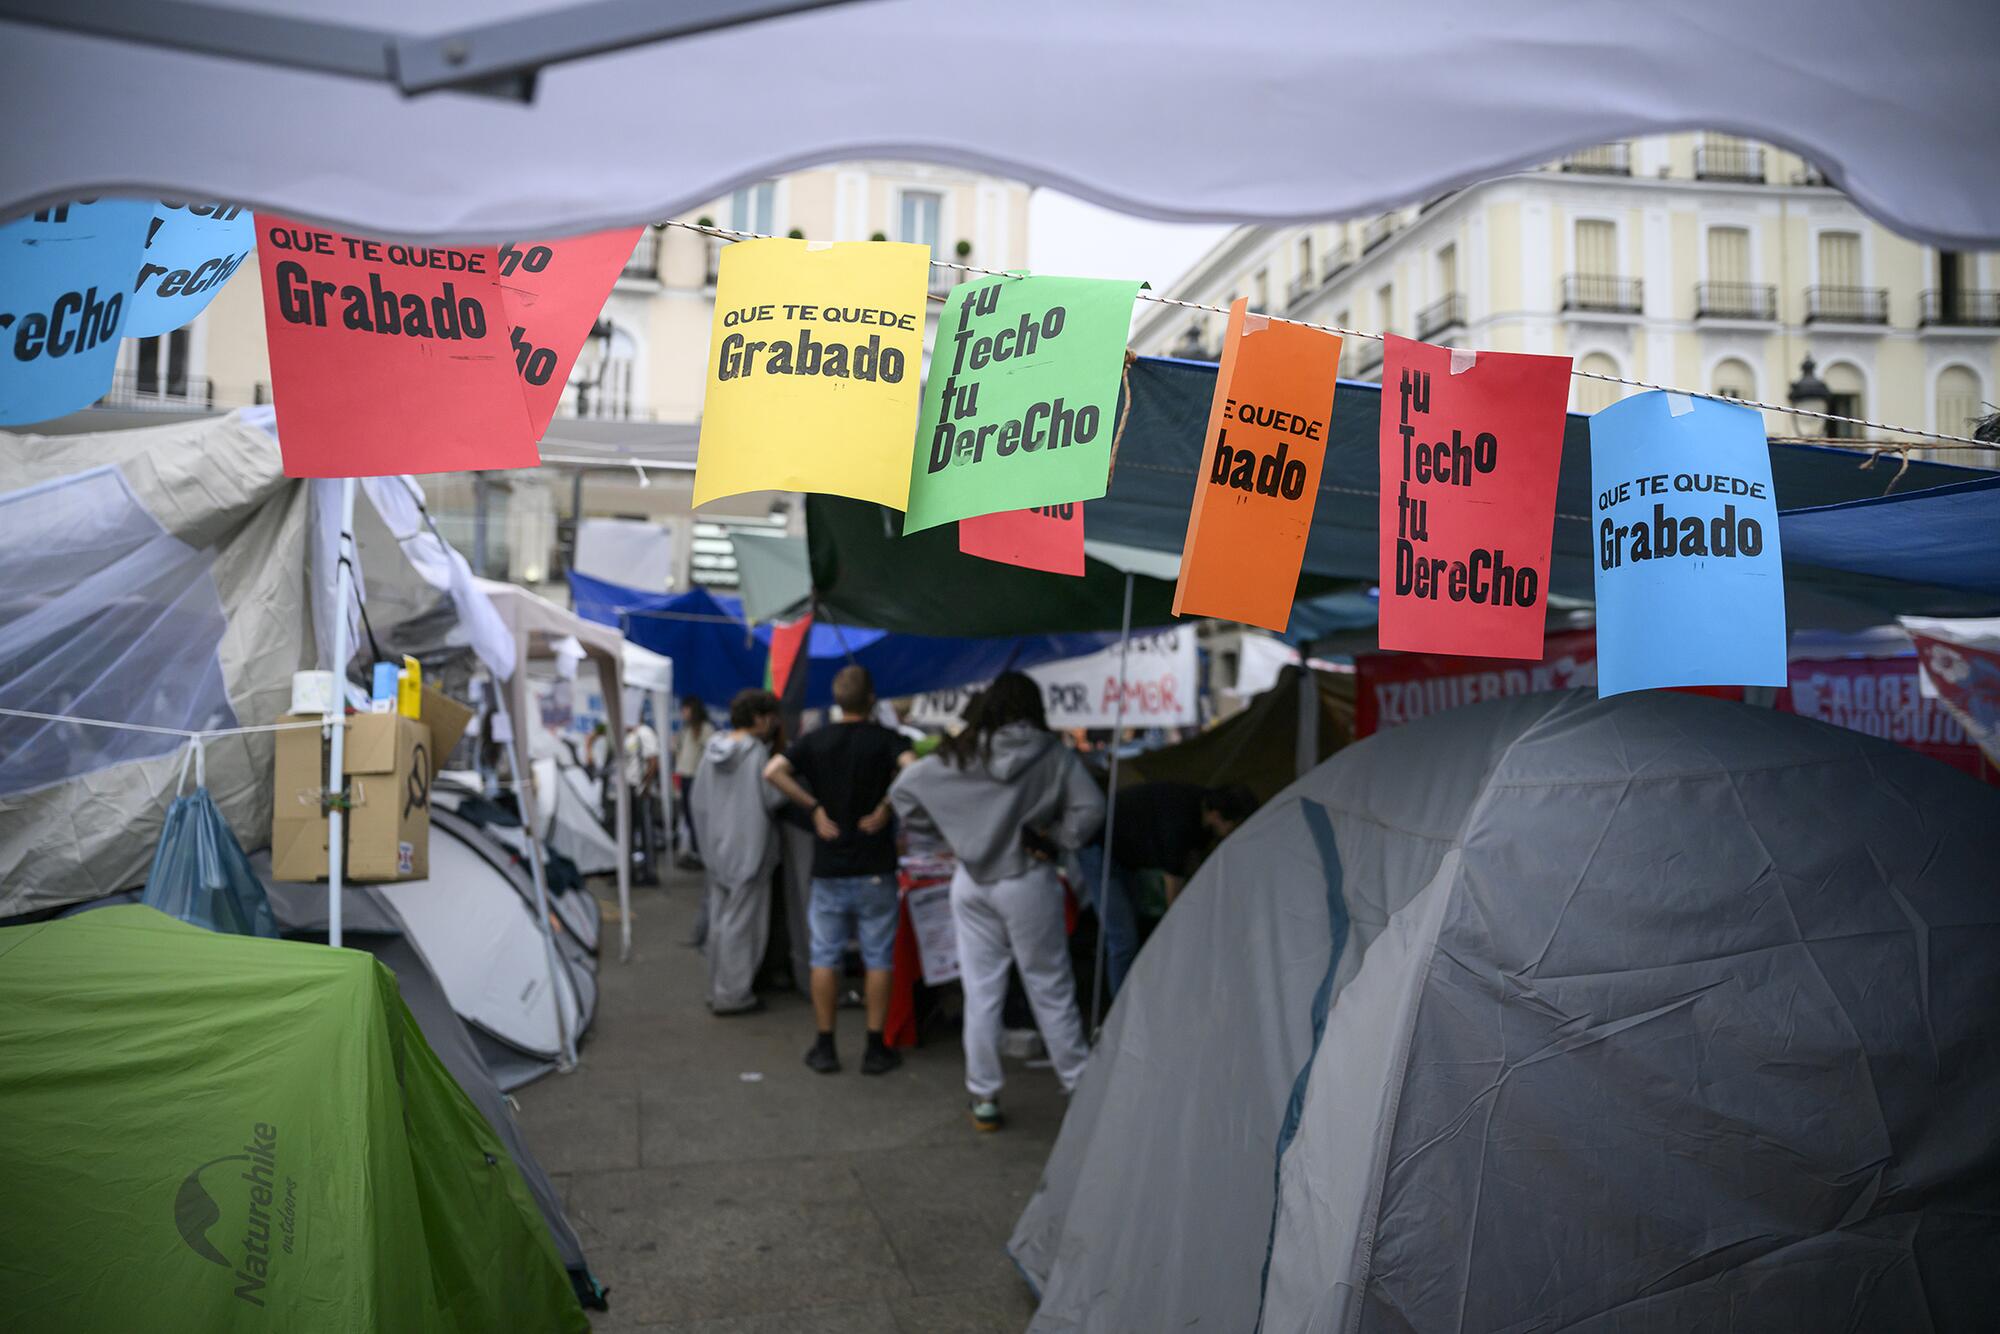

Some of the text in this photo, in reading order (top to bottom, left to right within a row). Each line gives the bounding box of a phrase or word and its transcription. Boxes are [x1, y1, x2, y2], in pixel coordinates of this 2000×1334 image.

[269, 227, 486, 274] QUE TE QUEDE
[276, 260, 487, 340] Grabado
[723, 304, 916, 331] QUE TE QUEDE
[957, 283, 1003, 332] tu
[718, 329, 905, 384] Grabado
[952, 306, 1066, 376] Techo
[938, 376, 980, 424] tu
[1238, 404, 1323, 441] QUEDE
[1399, 366, 1431, 424] tu
[927, 397, 1100, 475] DereCho
[1399, 423, 1498, 487] Techo
[1398, 481, 1429, 542] tu
[1598, 473, 1767, 511] QUE TE QUEDE
[1600, 503, 1763, 571] Grabado
[1395, 538, 1539, 608] DereCho
[1102, 674, 1184, 716] AMOR
[234, 1122, 277, 1308] Naturehike
[277, 1176, 298, 1255] outdoors
